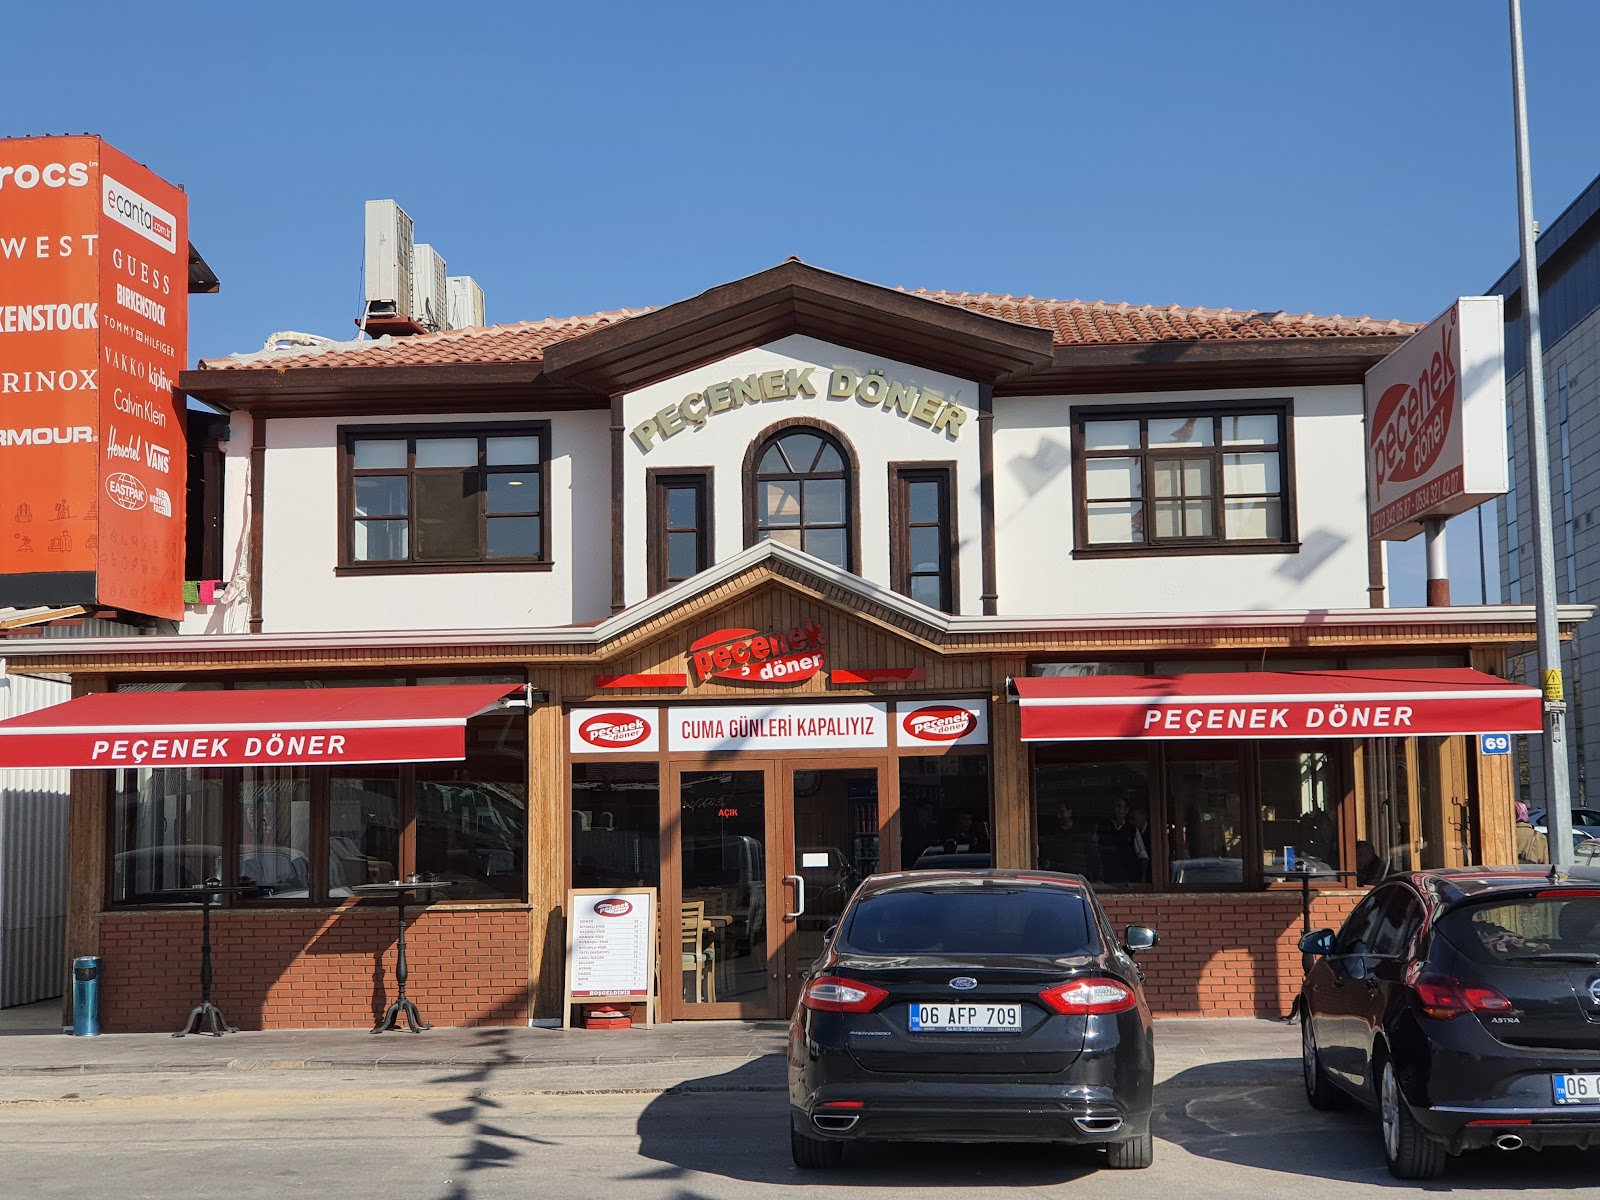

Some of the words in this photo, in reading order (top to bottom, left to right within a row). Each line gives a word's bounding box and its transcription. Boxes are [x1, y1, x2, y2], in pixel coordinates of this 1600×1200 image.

[1, 234, 99, 259] WEST
[113, 248, 170, 295] GUESS
[116, 283, 166, 327] BIRKENSTOCK
[104, 314, 135, 338] TOMMY
[144, 335, 175, 357] HILFIGER
[105, 346, 145, 379] VAKKO
[2, 369, 99, 393] RINOX
[113, 388, 144, 419] Calvin
[144, 399, 166, 428] Klein
[631, 367, 817, 452] PEÇENEK
[829, 368, 968, 440] DÖNER
[1375, 323, 1456, 502] peçenek
[107, 424, 141, 462] Herschel
[1413, 406, 1446, 473] döner
[145, 441, 170, 474] VANS
[109, 480, 145, 502] EASTPAK
[693, 618, 827, 681] peçenek
[760, 653, 822, 680] döner
[590, 719, 644, 741] peçenek
[681, 720, 725, 739] CUMA
[729, 715, 792, 738] GÜNLERİ
[797, 716, 875, 737] KAPALIYIZ
[914, 711, 969, 735] peçenek
[938, 722, 965, 733] döner
[1143, 707, 1290, 734] PEÇENEK
[1305, 703, 1414, 728] DÖNER
[91, 737, 230, 763] PEÇENEK
[244, 733, 346, 757] DÖNER
[613, 730, 640, 741] döner
[1485, 737, 1507, 750] 69
[718, 808, 739, 819] AÇIK
[920, 1007, 939, 1024] 06
[948, 1007, 977, 1025] AFP
[987, 1008, 1016, 1026] 709
[1491, 1017, 1521, 1025] ASTRA
[1567, 1077, 1588, 1096] 06
